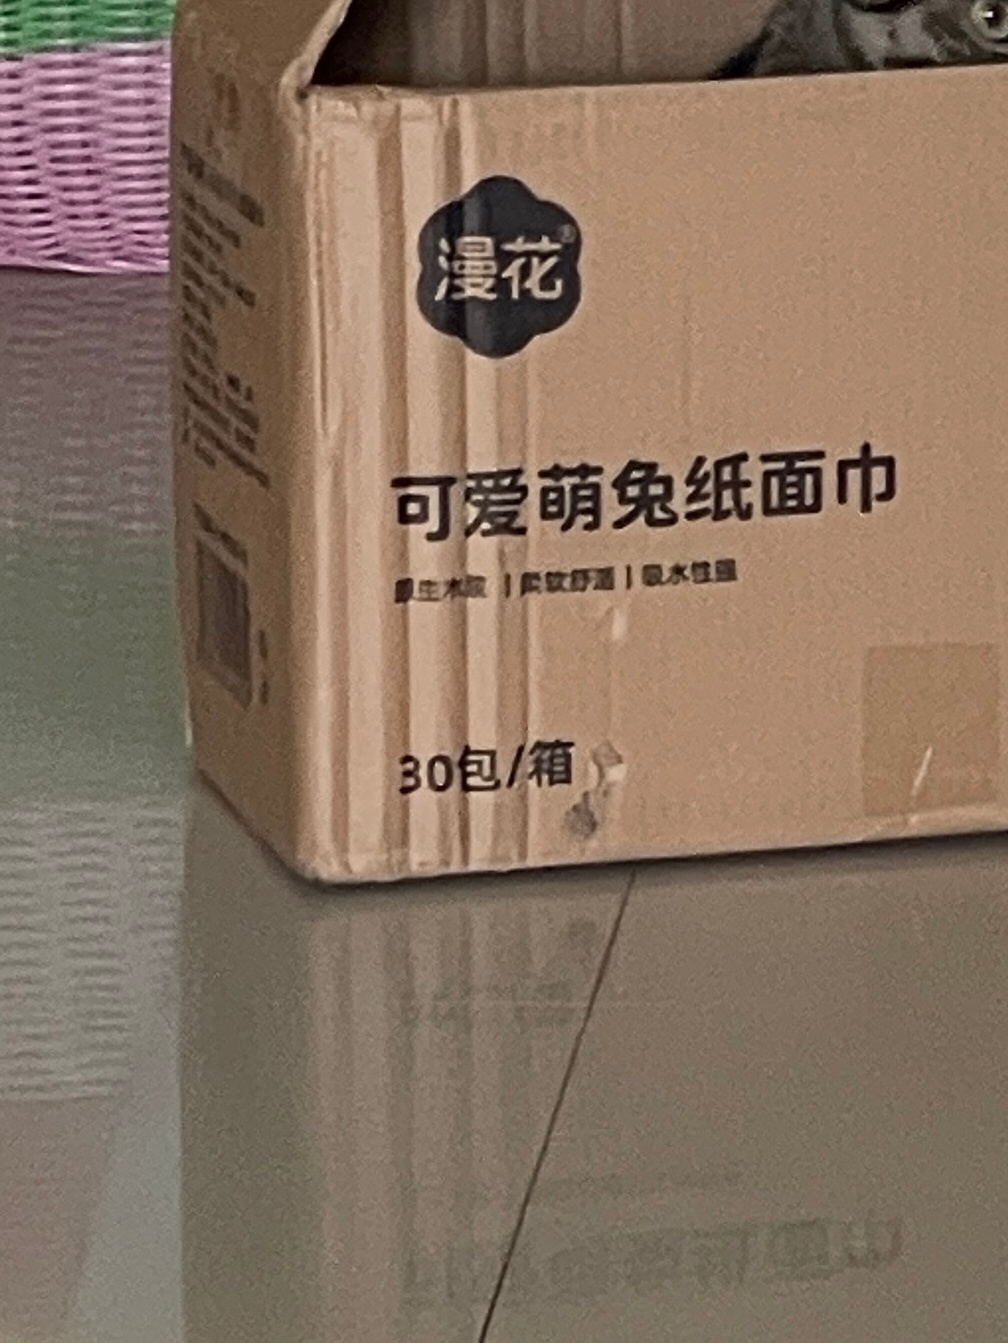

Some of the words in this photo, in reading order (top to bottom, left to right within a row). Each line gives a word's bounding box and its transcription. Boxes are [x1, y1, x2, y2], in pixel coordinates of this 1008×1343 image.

[434, 235, 563, 302] 漫花
[391, 441, 897, 542] 可爱萌兔纸面巾
[398, 739, 576, 795] 30包/箱
